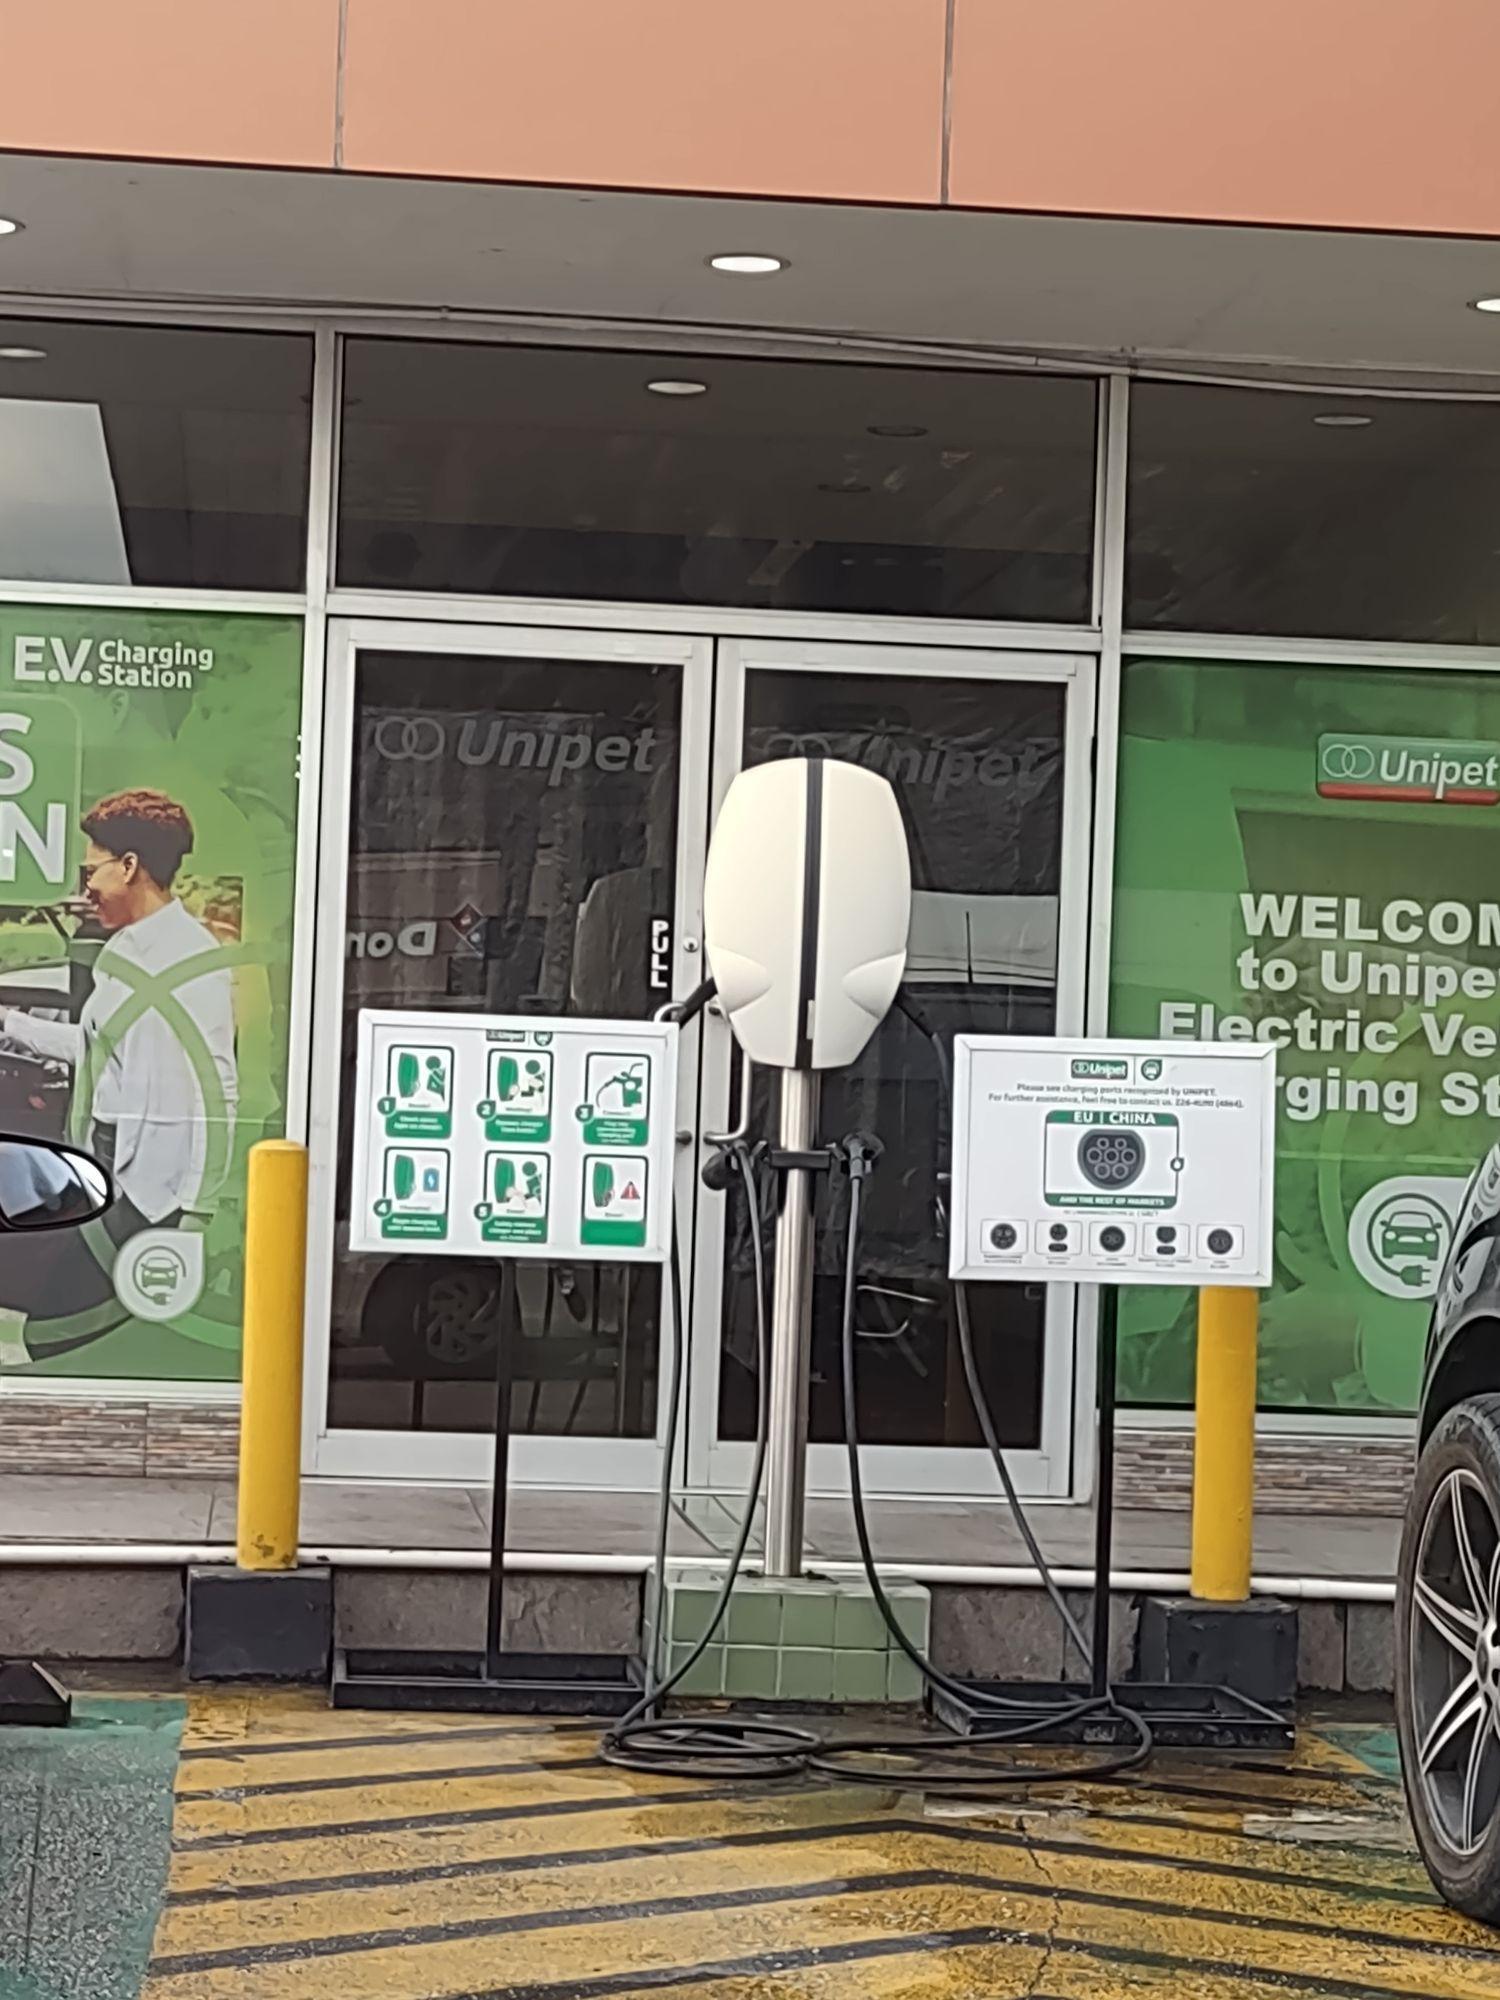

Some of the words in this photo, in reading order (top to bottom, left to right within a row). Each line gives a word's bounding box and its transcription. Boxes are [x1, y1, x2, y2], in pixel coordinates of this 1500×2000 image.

[14, 636, 93, 683] E.V.
[99, 639, 214, 671] Charging
[98, 664, 193, 689] Station
[457, 719, 657, 787] Unipet
[1379, 749, 1499, 799] Unipet
[651, 920, 669, 988] PULL
[1236, 946, 1298, 991] to
[1321, 950, 1500, 1007] Unipe
[1159, 1001, 1400, 1054] Electric
[1420, 1012, 1498, 1058] Ve
[1090, 1062, 1126, 1079] Unipet
[988, 1093, 1002, 1102] For
[1004, 1093, 1034, 1102] further
[1099, 1096, 1117, 1104] free
[1016, 1083, 1045, 1092] Please
[1062, 1085, 1098, 1095] charging
[1171, 1087, 1181, 1096] by
[481, 1104, 491, 1116] 2
[1073, 1111, 1093, 1123] EU
[1109, 1112, 1156, 1125] CHINA
